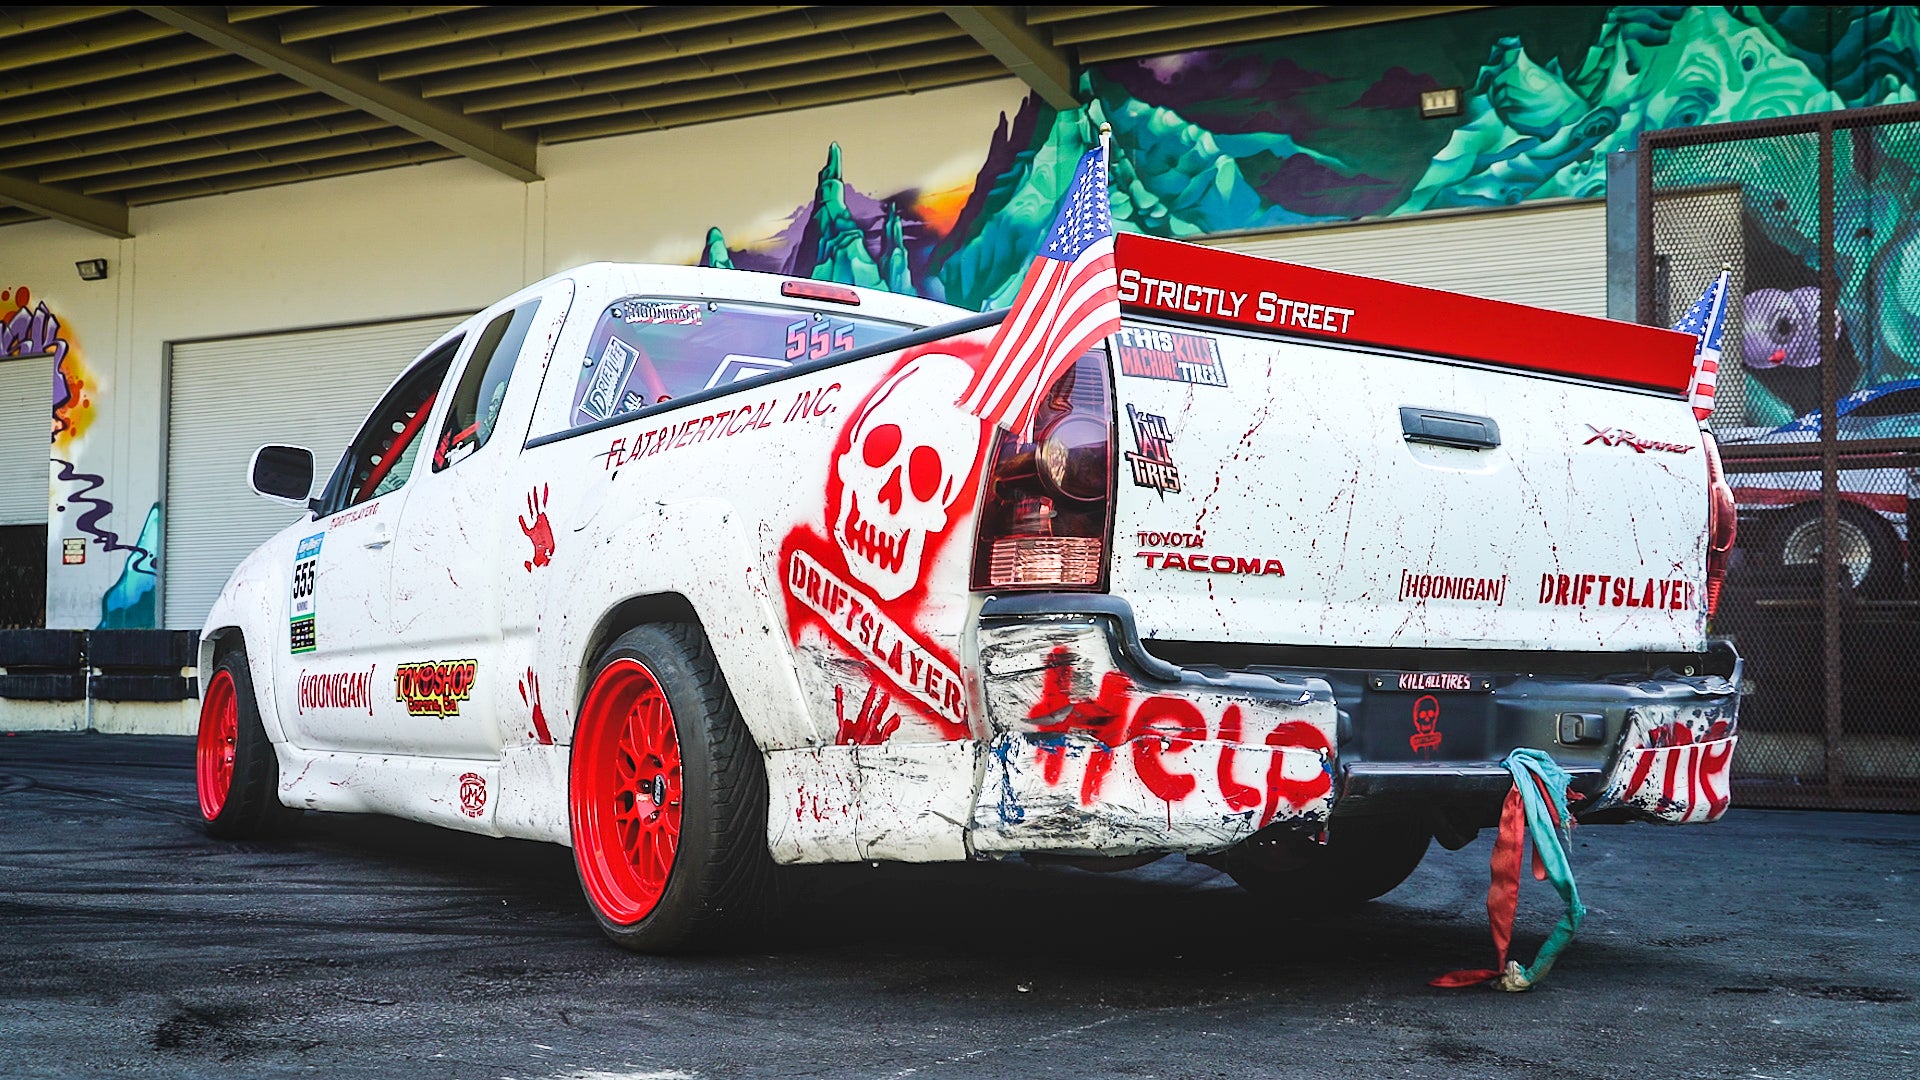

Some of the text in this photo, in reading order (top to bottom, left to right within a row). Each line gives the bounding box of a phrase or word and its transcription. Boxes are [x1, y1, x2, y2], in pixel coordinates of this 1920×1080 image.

[1118, 268, 1355, 334] STRICTLY STREET
[785, 319, 855, 361] 555
[1120, 328, 1174, 352] THIS
[1172, 334, 1213, 365] KILLS
[1119, 347, 1181, 380] MACHINE
[1177, 361, 1220, 384] TIRES
[606, 383, 842, 470] FLAT&VERTICAL INC.
[1137, 531, 1204, 548] TOYOTA
[293, 559, 316, 599] 555
[1135, 552, 1285, 577] TACOMA
[1538, 572, 1698, 611] DRIFTSLAYER
[792, 556, 963, 718] DRIFTSLAYER
